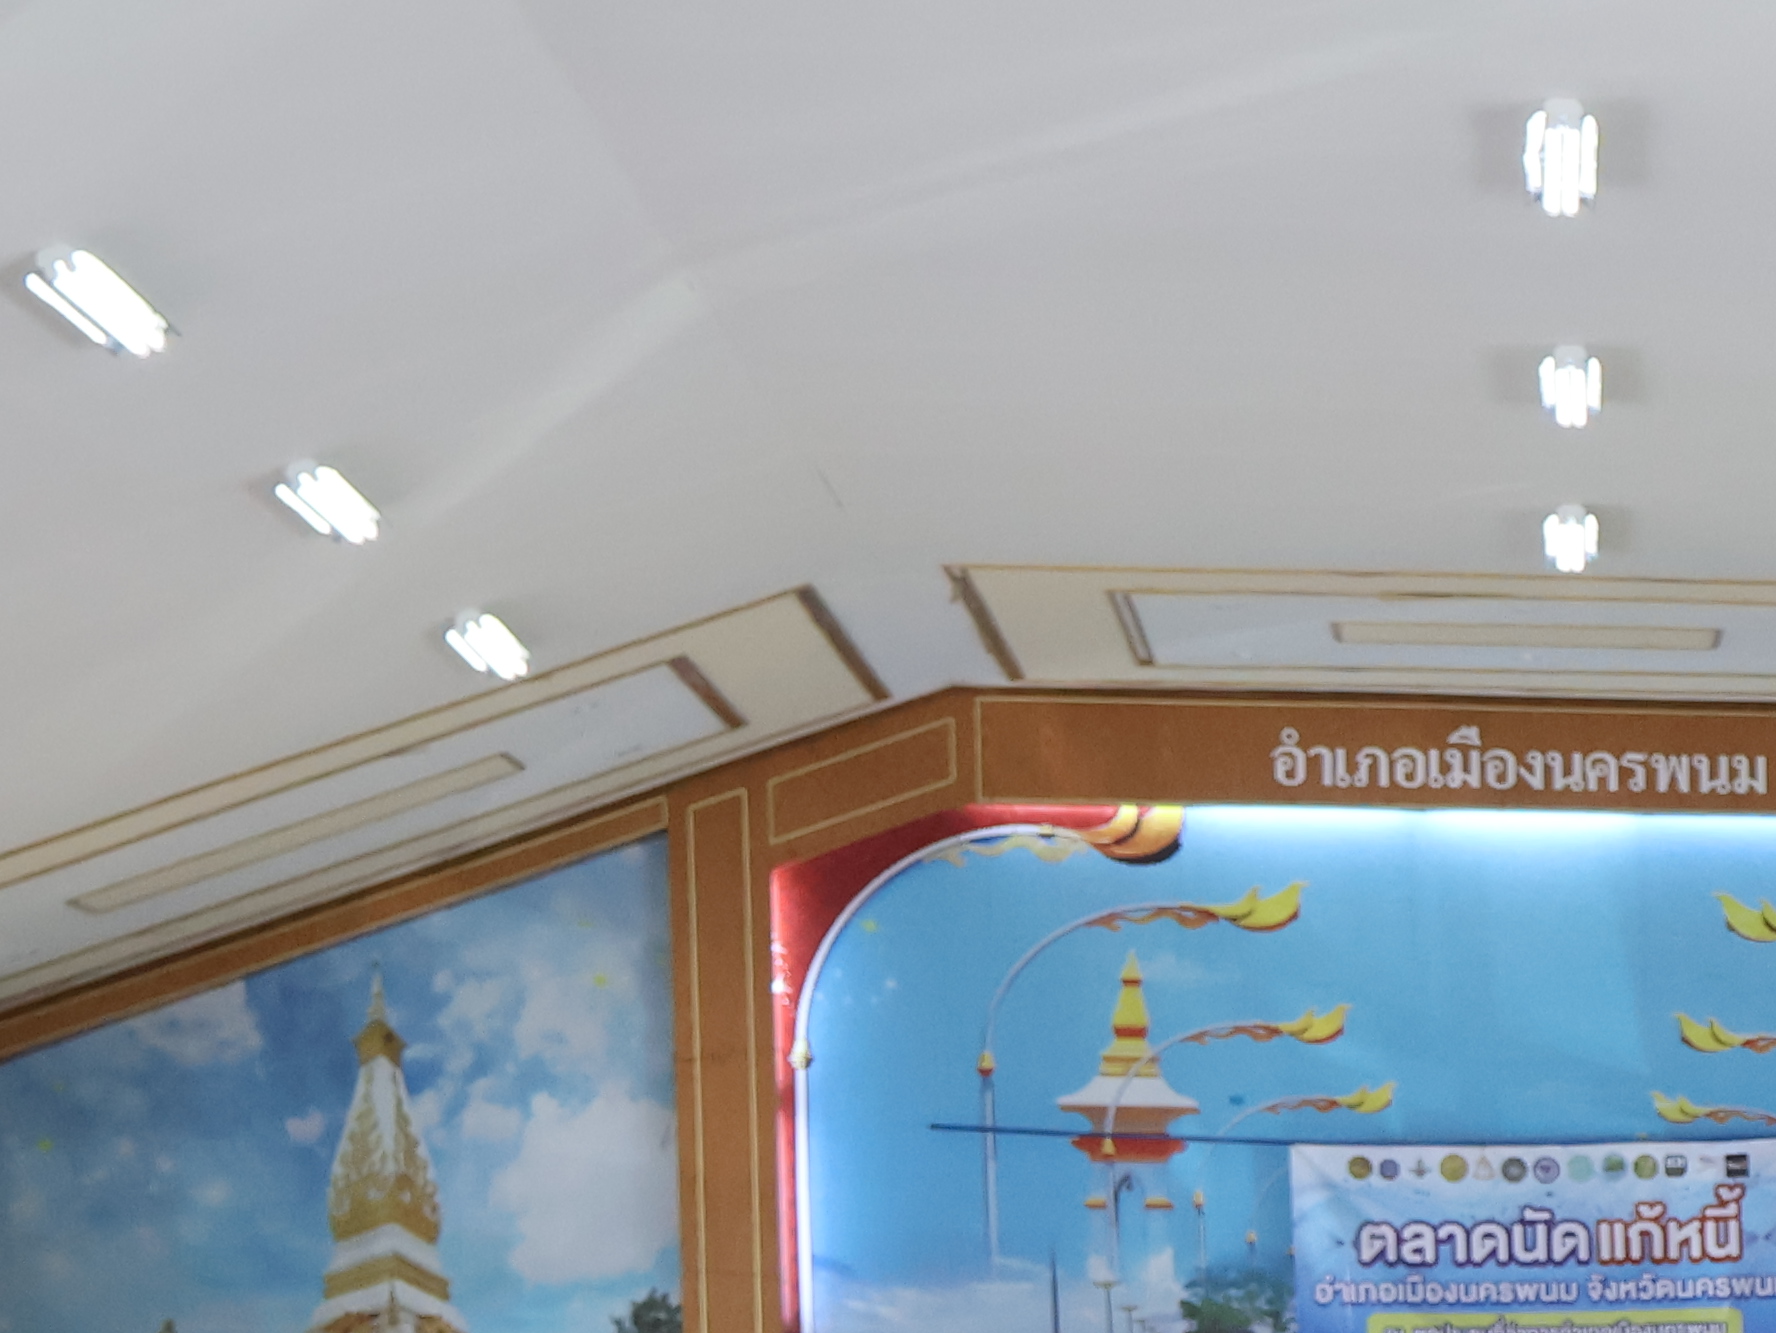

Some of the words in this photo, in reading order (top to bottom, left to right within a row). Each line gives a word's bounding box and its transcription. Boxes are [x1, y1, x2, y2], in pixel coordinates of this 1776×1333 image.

[1270, 725, 1769, 796] อำเภอเมืองนครพนม
[1356, 1183, 1744, 1266] ตลาดนัดแก้หนี้
